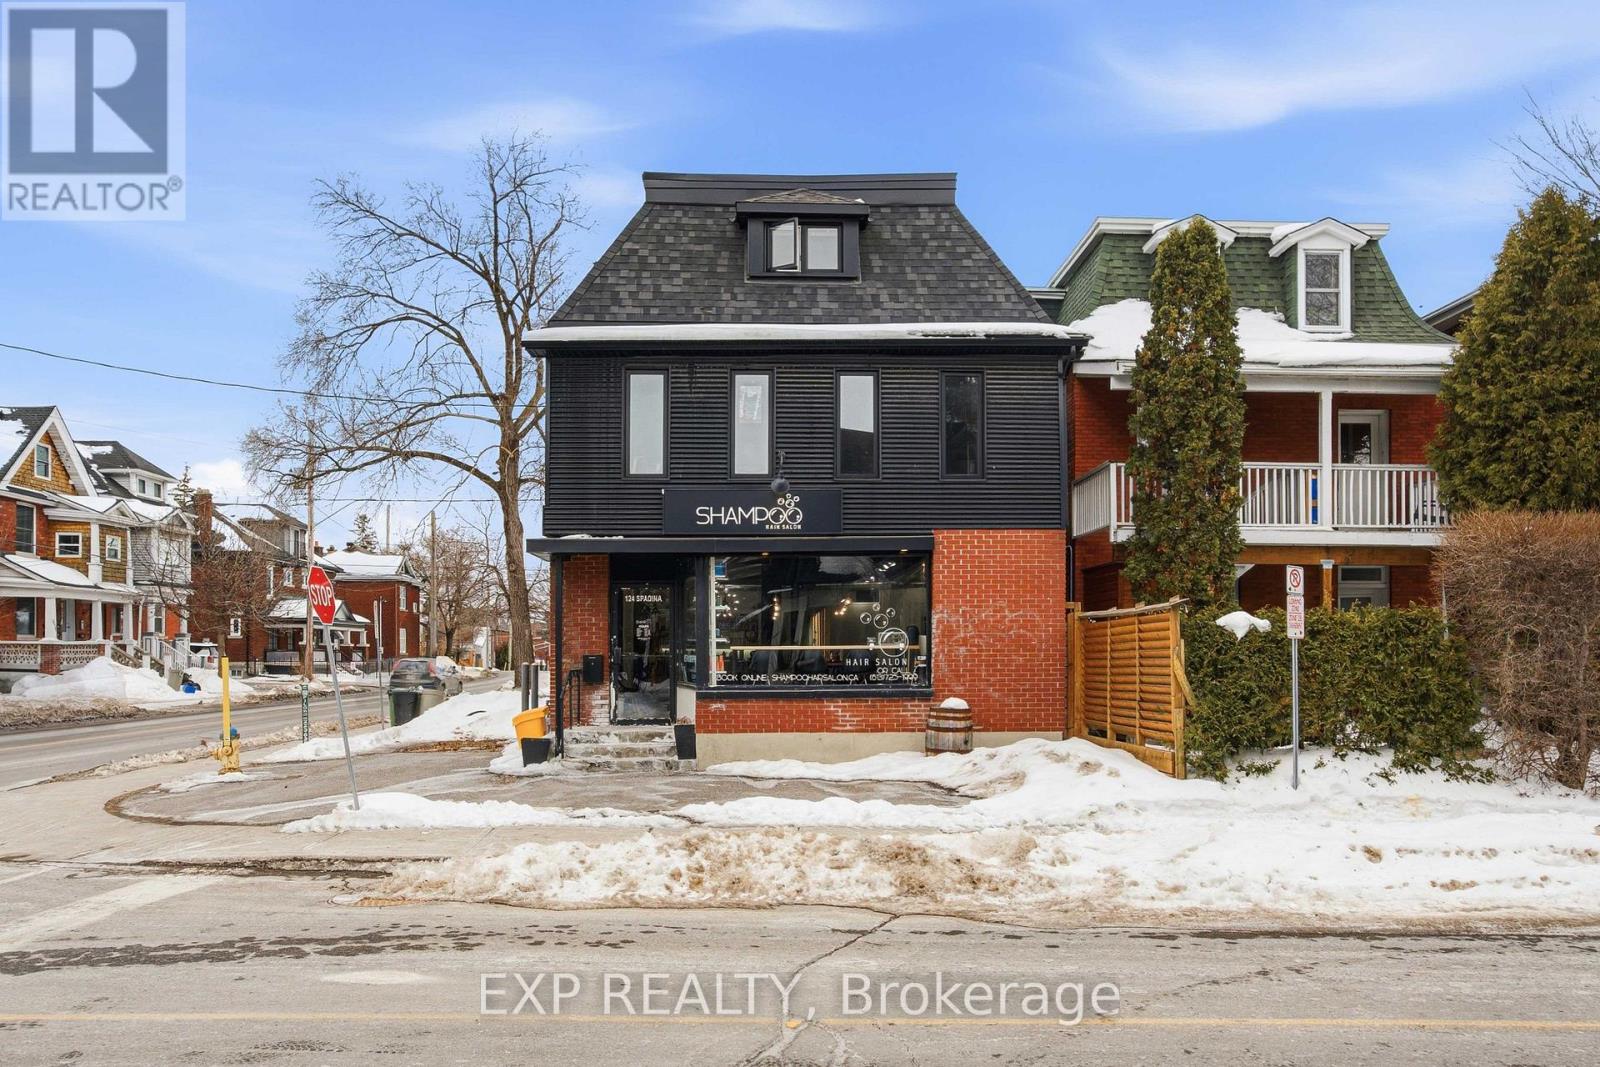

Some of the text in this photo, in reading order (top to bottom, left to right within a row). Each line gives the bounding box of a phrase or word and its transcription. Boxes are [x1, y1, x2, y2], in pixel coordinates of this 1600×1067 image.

[695, 506, 803, 525] SHAMPOO
[310, 584, 332, 606] STOP
[846, 658, 908, 666] HAIR SALON
[717, 674, 738, 682] BOOK
